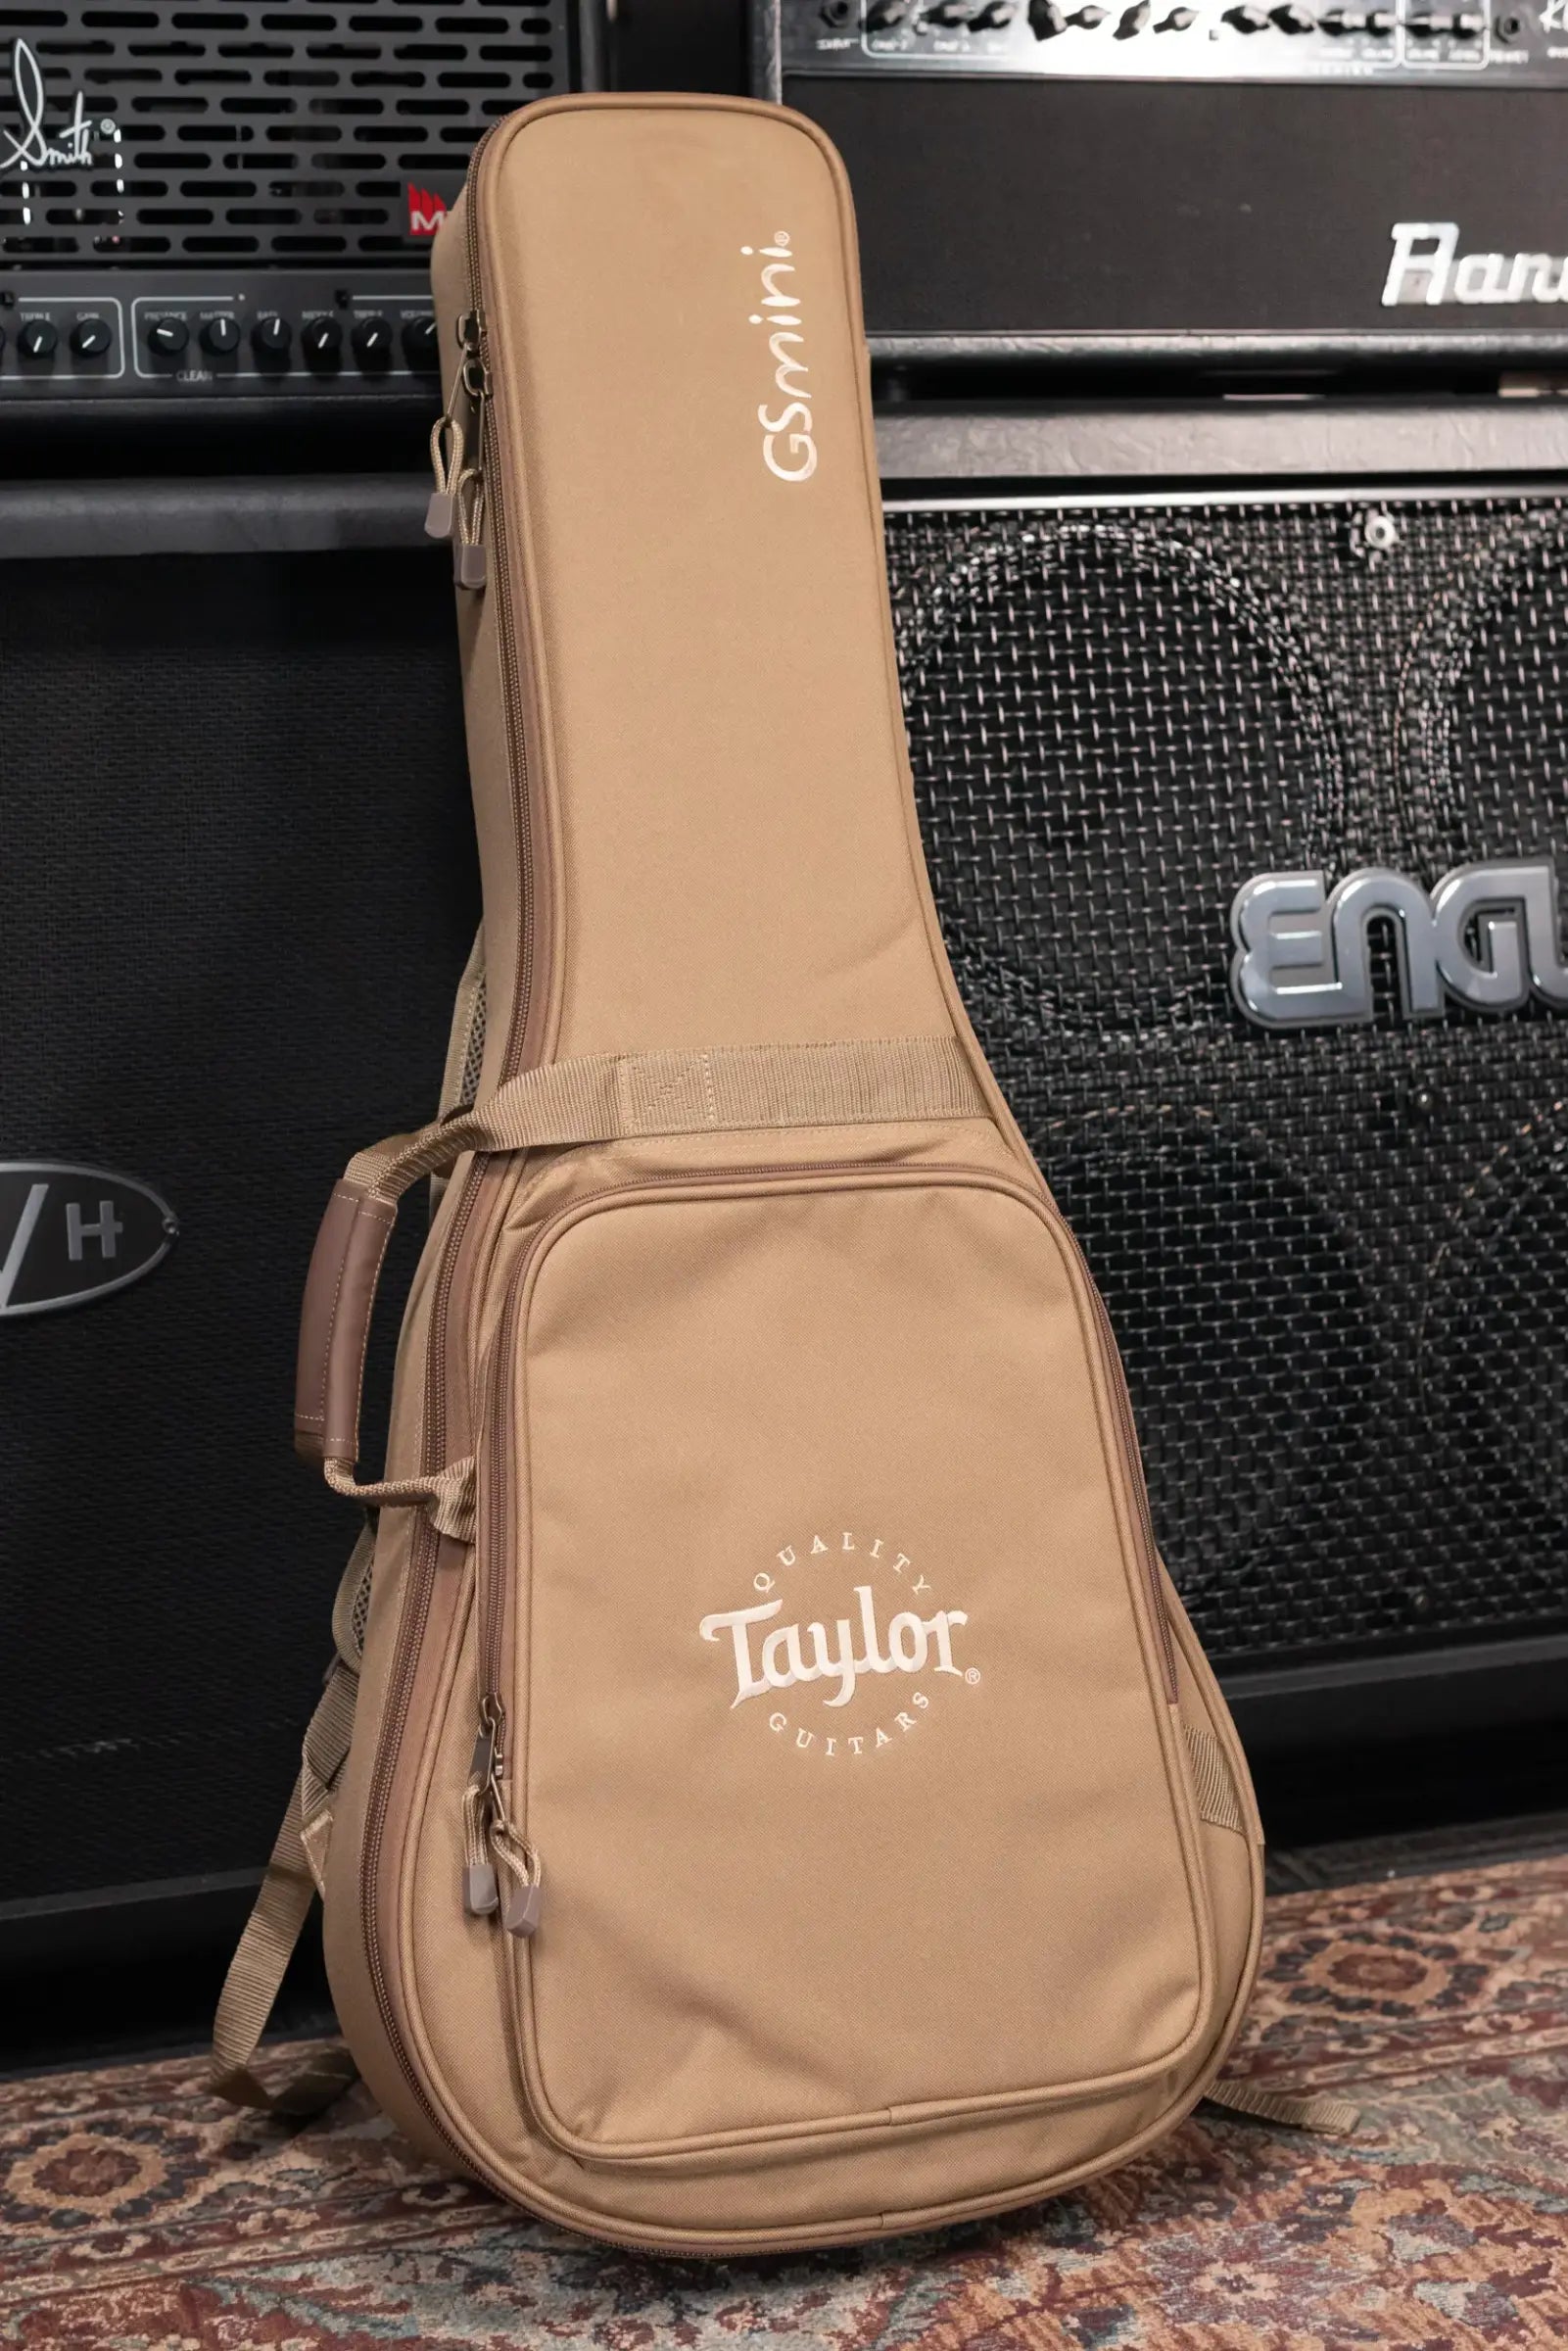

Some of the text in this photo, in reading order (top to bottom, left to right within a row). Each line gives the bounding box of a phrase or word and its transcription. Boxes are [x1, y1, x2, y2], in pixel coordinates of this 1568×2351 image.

[1382, 222, 1568, 307] Ran
[753, 1531, 930, 1596] QUALITY
[769, 1691, 930, 1756] GUITARS
